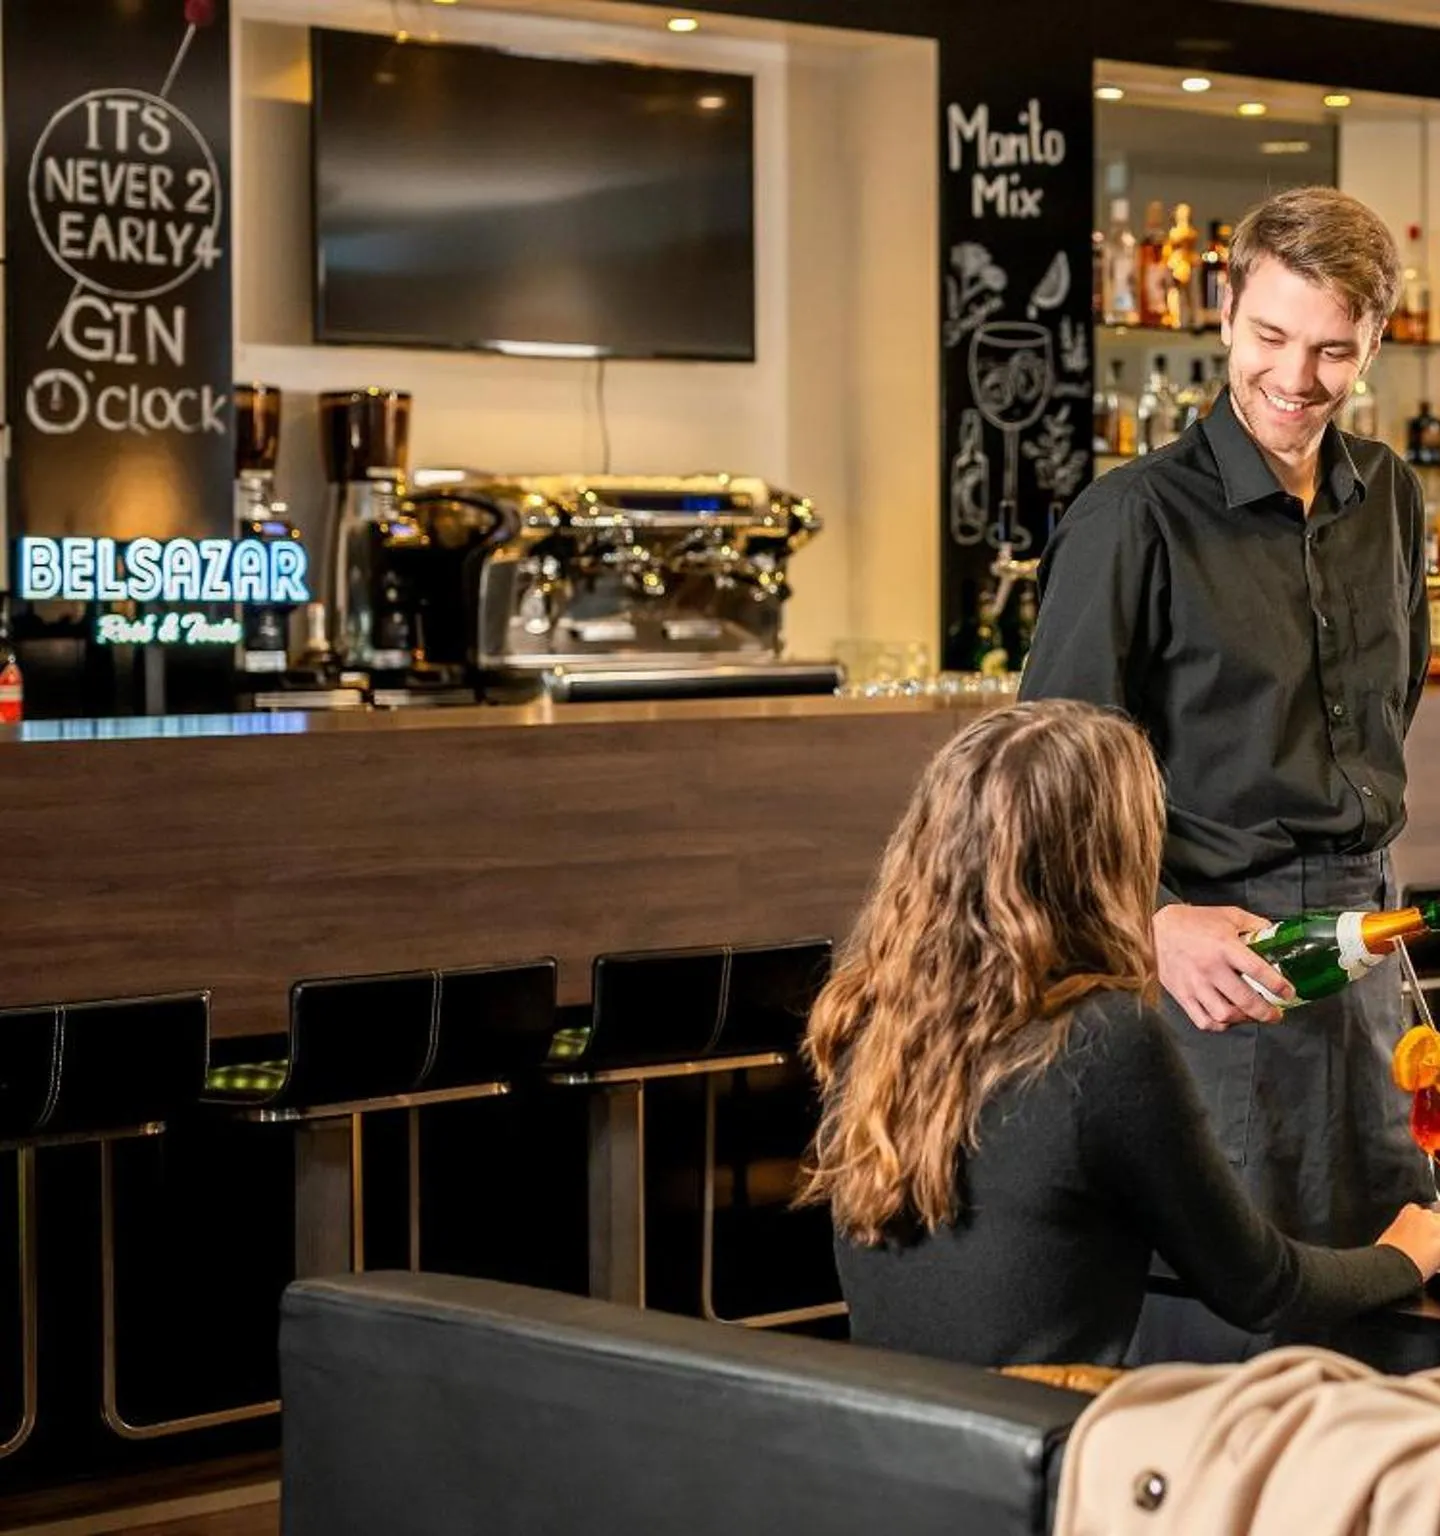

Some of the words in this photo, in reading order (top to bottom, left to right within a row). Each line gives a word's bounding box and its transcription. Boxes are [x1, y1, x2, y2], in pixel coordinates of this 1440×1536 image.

[85, 100, 171, 155] ITS
[44, 157, 174, 212] NEVER
[184, 168, 212, 214] 2
[971, 172, 1044, 219] Mix
[58, 211, 194, 269] EARLY
[61, 295, 186, 367] GIN
[20, 536, 310, 601] BELSAZAR
